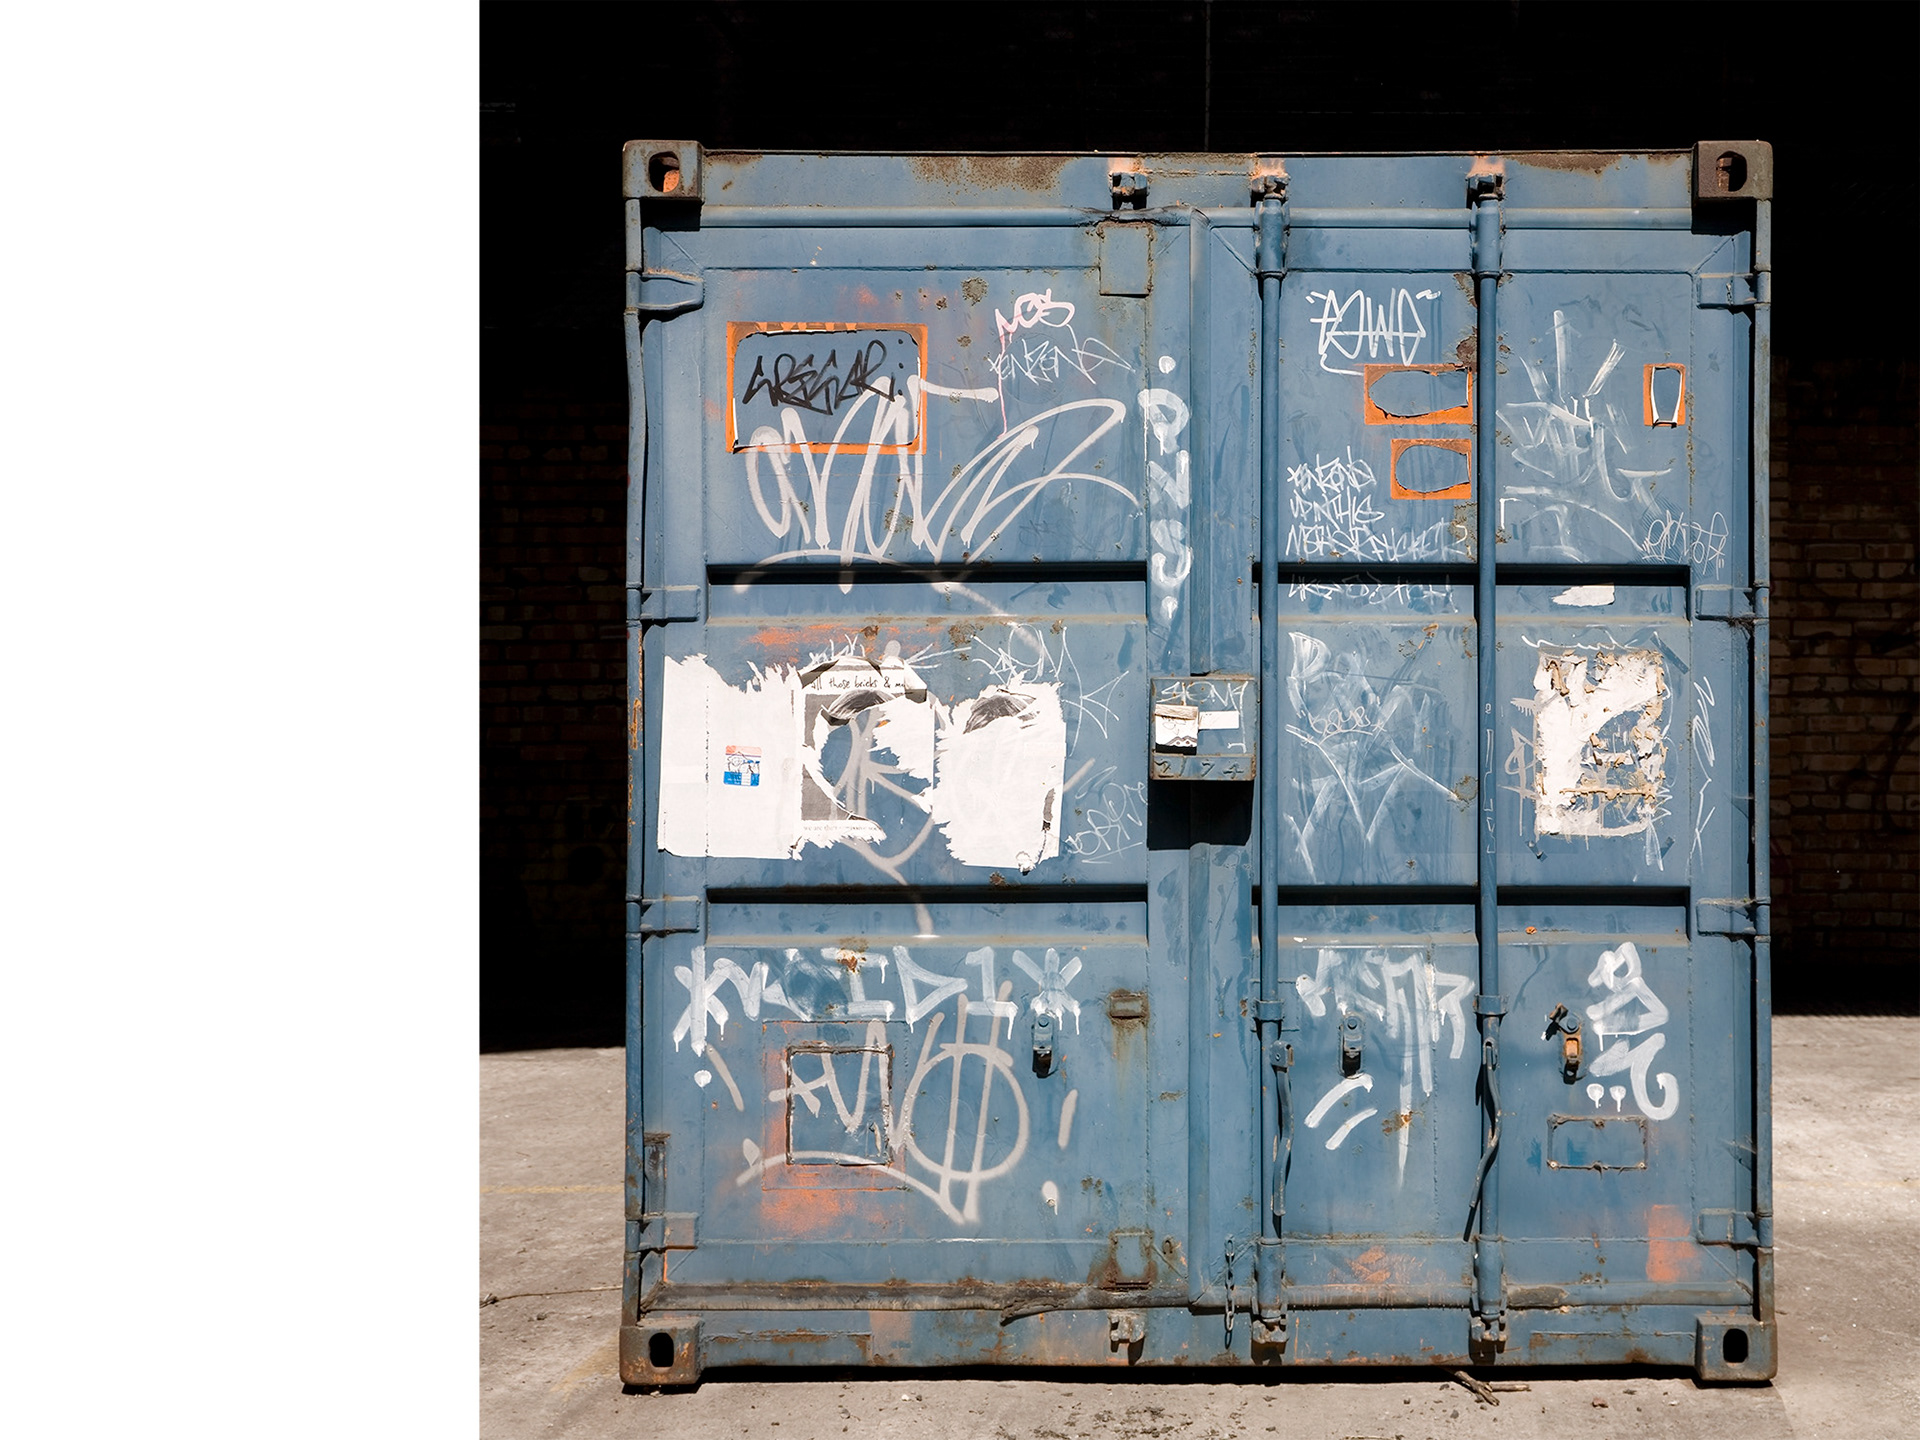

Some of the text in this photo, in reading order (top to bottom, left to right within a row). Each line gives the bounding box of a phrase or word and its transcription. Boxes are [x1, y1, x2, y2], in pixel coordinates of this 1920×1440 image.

[829, 677, 850, 689] those
[854, 675, 878, 689] bricks
[884, 675, 891, 689] &
